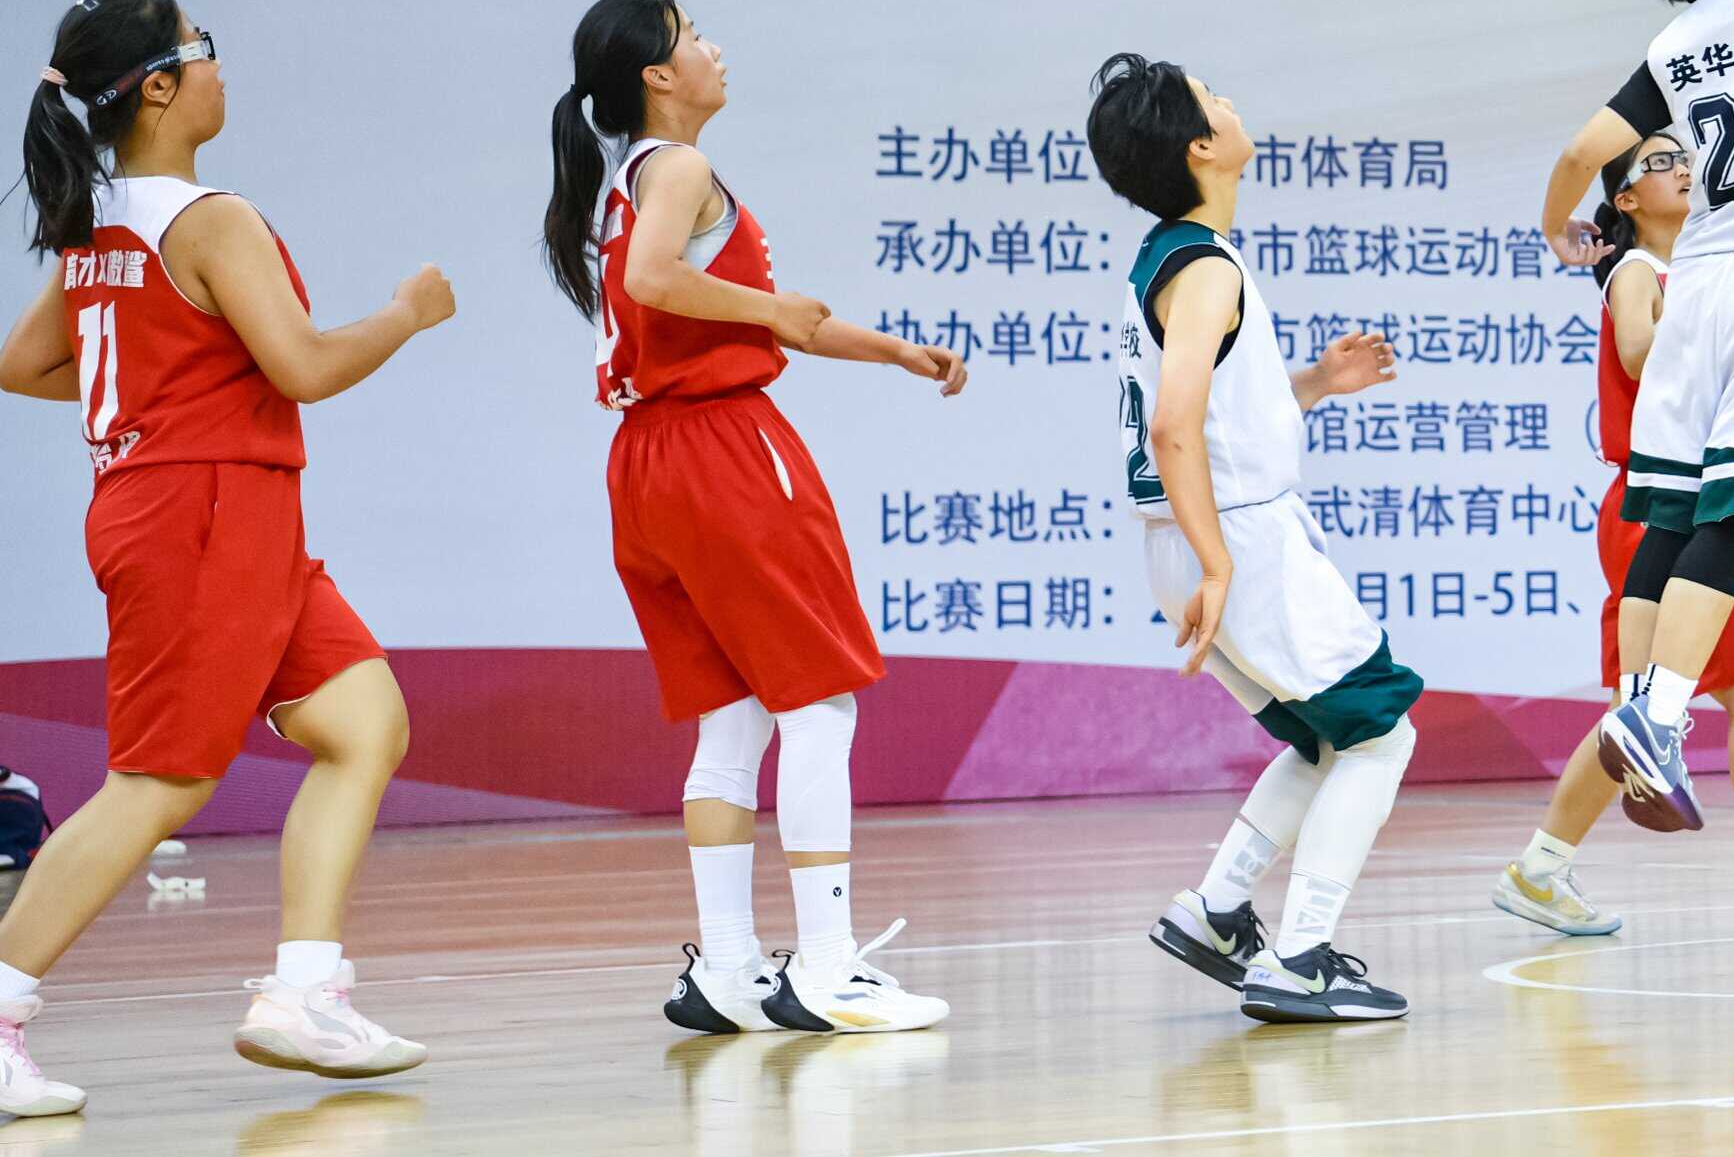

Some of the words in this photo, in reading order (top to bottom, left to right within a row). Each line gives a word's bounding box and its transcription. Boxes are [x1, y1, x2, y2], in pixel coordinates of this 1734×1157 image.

[1239, 135, 1447, 189] 市体育局
[78, 300, 119, 442] 11
